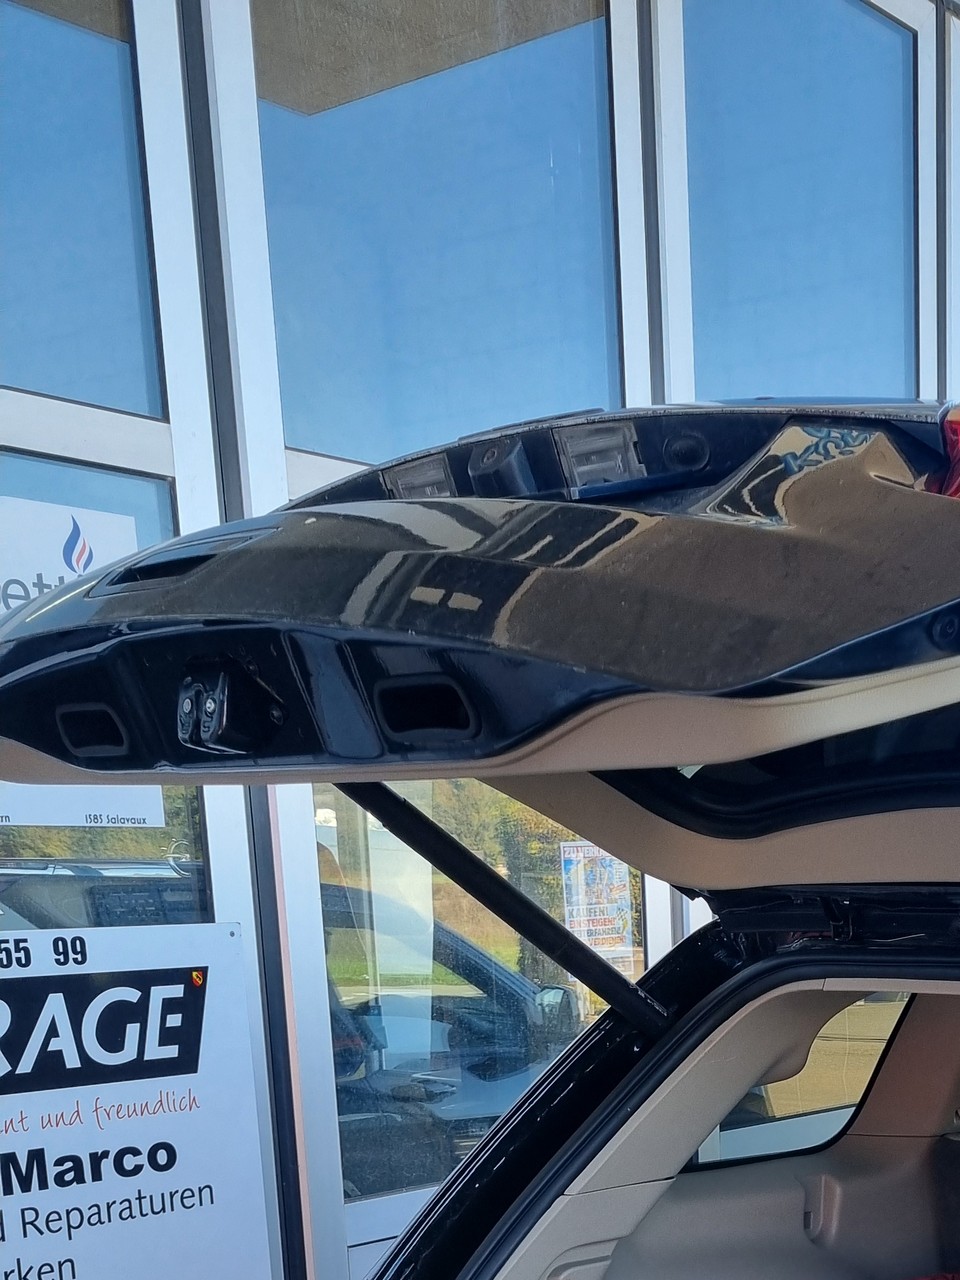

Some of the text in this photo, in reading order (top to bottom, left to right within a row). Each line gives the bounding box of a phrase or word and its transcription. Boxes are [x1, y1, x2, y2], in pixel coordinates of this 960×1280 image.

[85, 814, 147, 824] 1585 Salavaux
[0, 935, 88, 969] 55 99
[0, 1088, 200, 1135] nt und freundlich
[0, 1141, 178, 1196] Marco
[22, 1183, 215, 1241] Reparaturen
